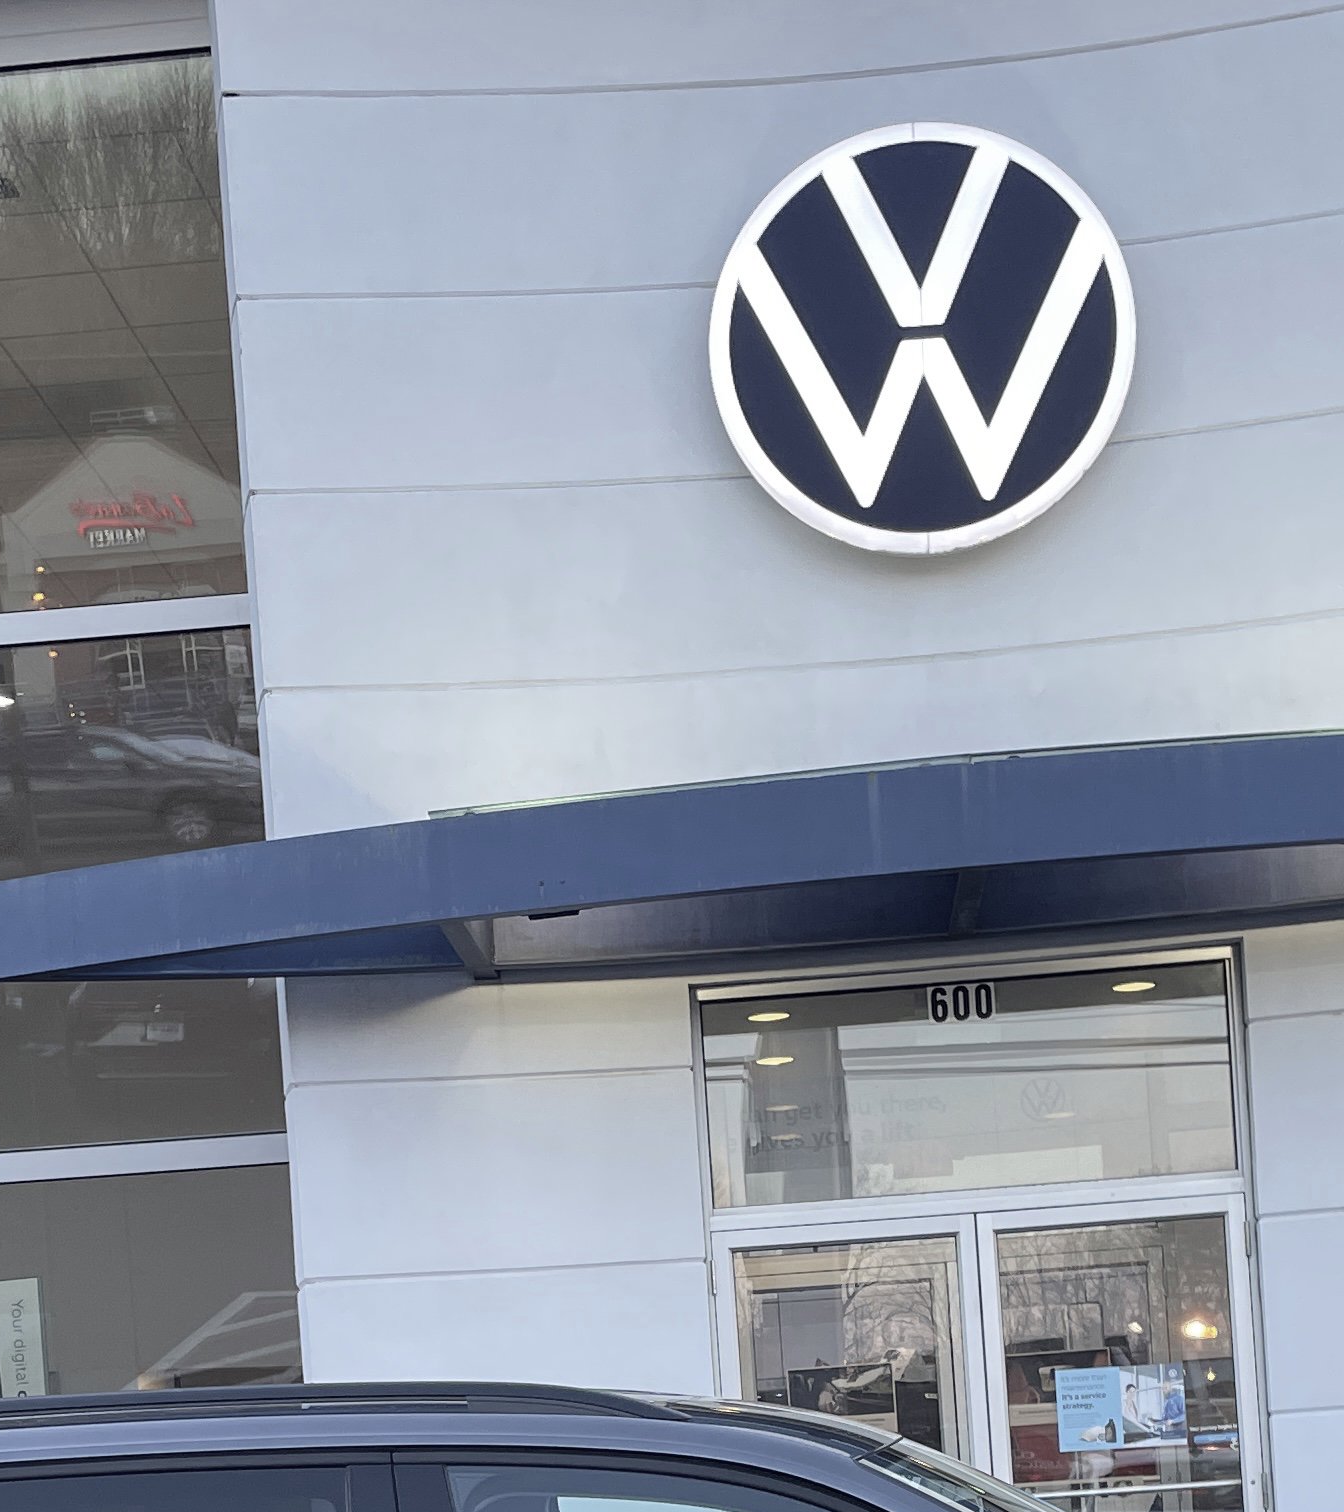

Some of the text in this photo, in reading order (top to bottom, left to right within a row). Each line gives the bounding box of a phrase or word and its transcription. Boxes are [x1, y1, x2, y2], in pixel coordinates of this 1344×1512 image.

[931, 984, 992, 1023] 600
[785, 1101, 823, 1126] get
[880, 1095, 948, 1115] there,
[12, 1299, 25, 1333] Your
[12, 1338, 30, 1386] digital
[1081, 1392, 1107, 1400] service
